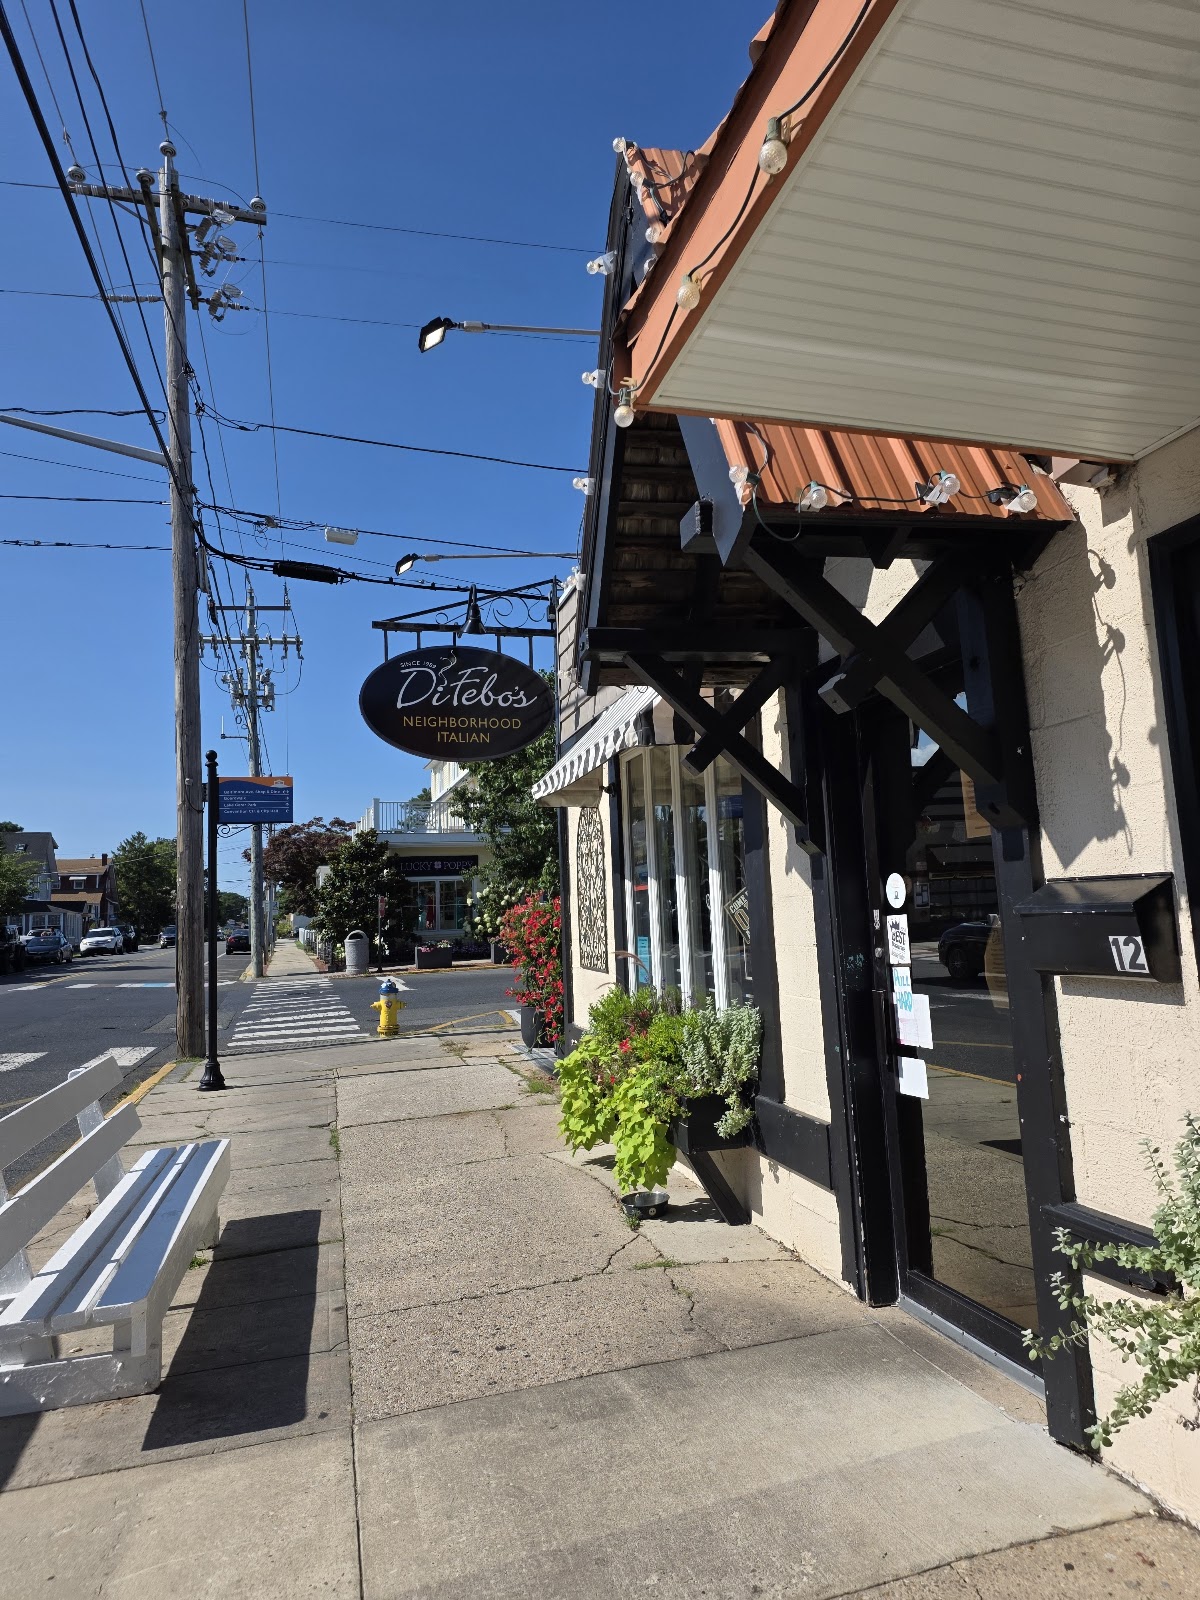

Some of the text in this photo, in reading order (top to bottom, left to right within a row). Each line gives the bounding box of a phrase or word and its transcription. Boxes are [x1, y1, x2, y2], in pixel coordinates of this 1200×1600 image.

[400, 660, 421, 668] SINCE
[396, 666, 538, 709] DiFebo's
[403, 715, 522, 729] NEIGHBORHOOD
[437, 731, 490, 743] ITALIAN
[400, 860, 474, 871] LUCKY POPPY
[1111, 936, 1147, 971] 12
[893, 968, 911, 987] PULL
[895, 990, 913, 1013] HARD
